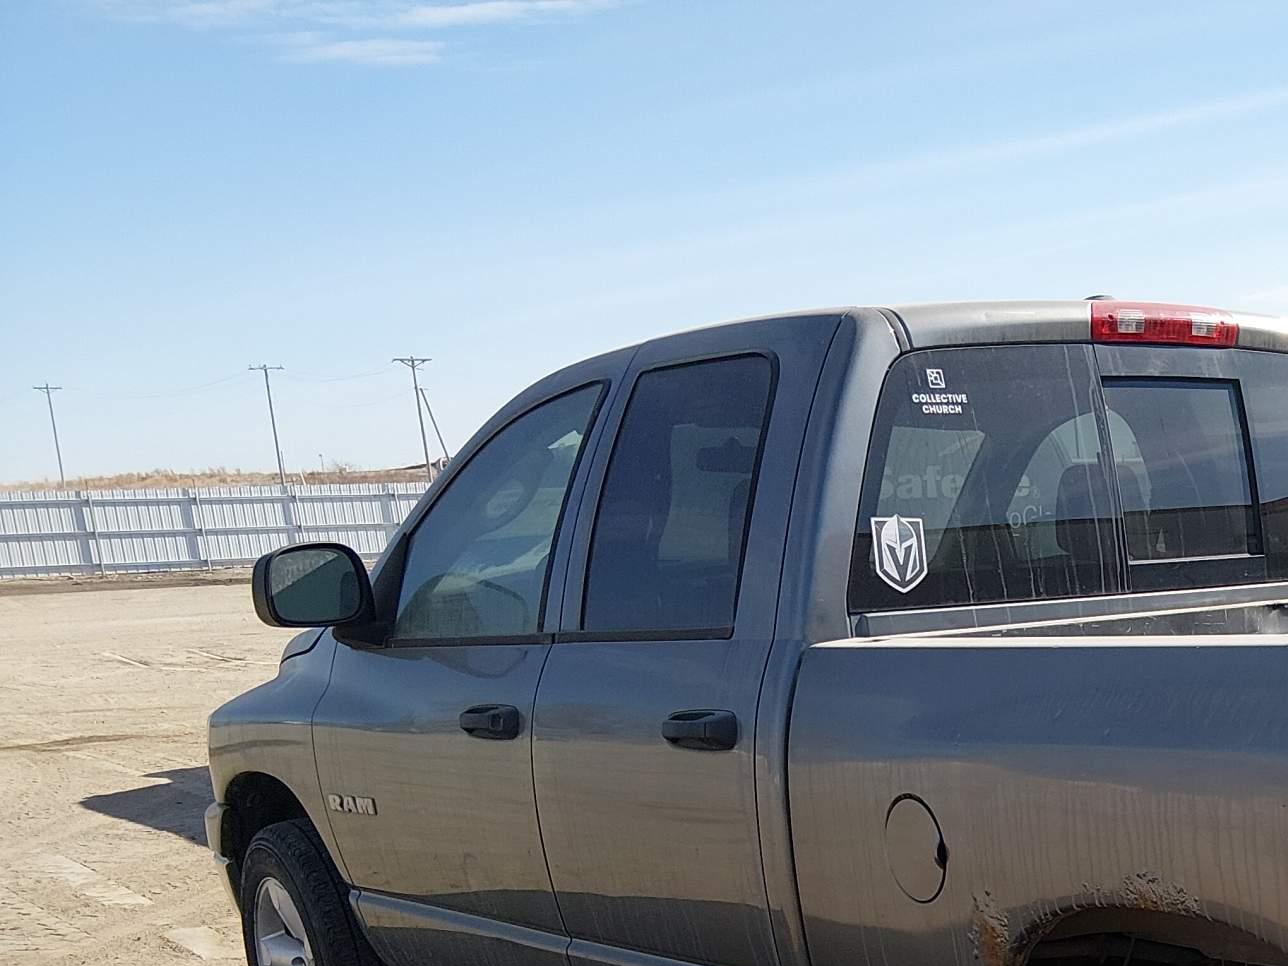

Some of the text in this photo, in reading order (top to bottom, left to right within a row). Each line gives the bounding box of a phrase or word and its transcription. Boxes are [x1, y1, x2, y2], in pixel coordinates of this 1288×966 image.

[912, 393, 968, 403] COLLECTIVE
[922, 404, 963, 414] CHURCH
[328, 794, 377, 815] RAM
